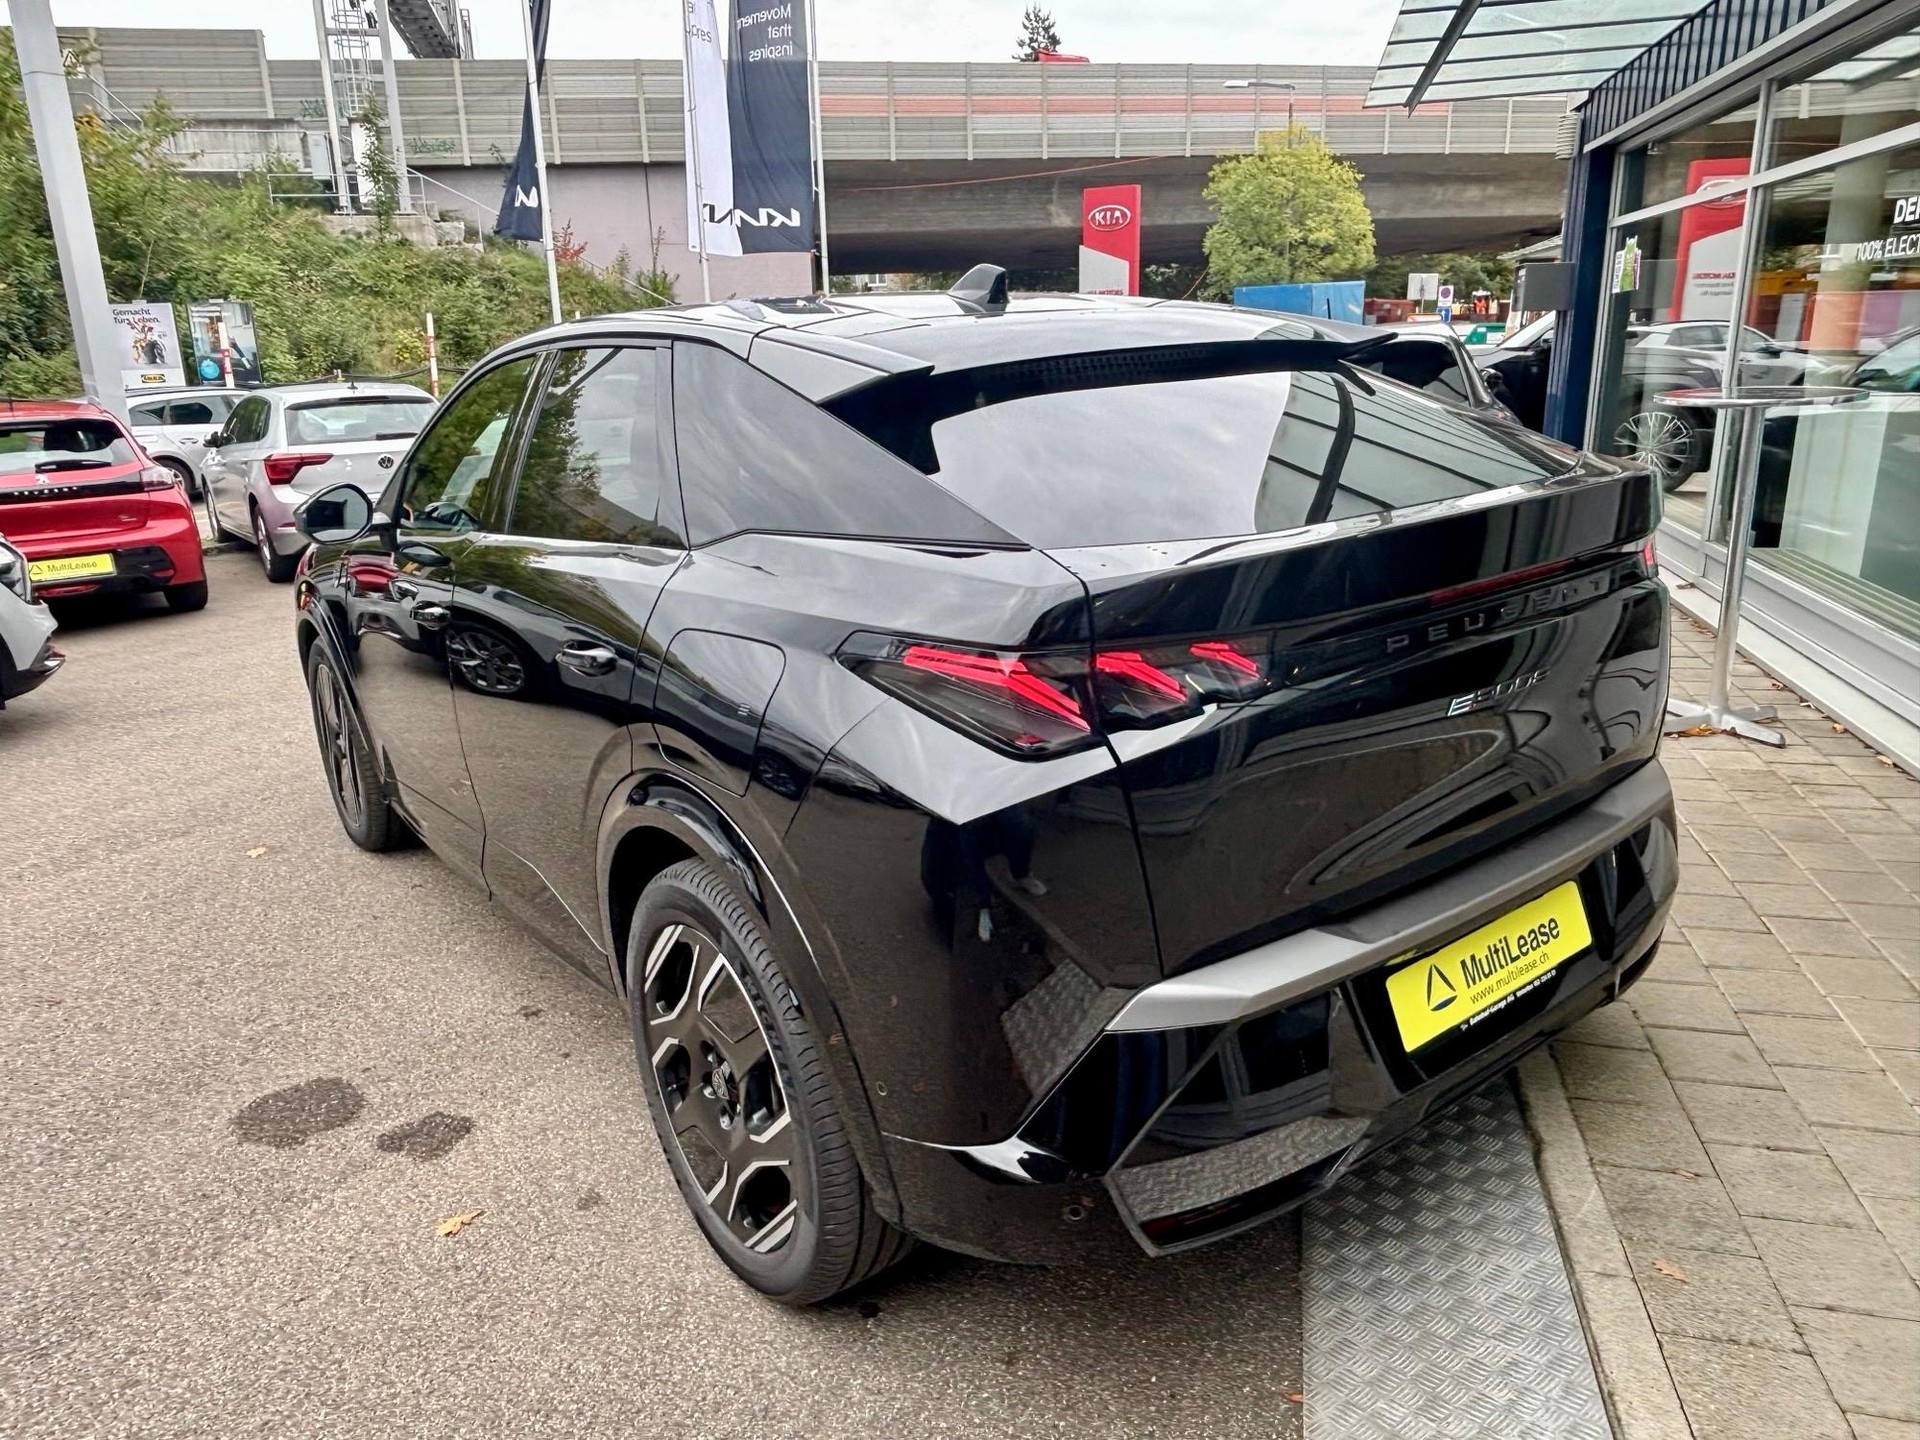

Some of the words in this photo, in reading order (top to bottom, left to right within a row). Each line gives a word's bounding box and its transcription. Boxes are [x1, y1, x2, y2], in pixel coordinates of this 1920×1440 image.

[1094, 210, 1123, 226] KIA
[1857, 240, 1884, 261] 100%
[46, 561, 98, 573] MultiLease
[1459, 916, 1561, 990] MultiLease
[1469, 951, 1550, 1005] www.multilease.ch
